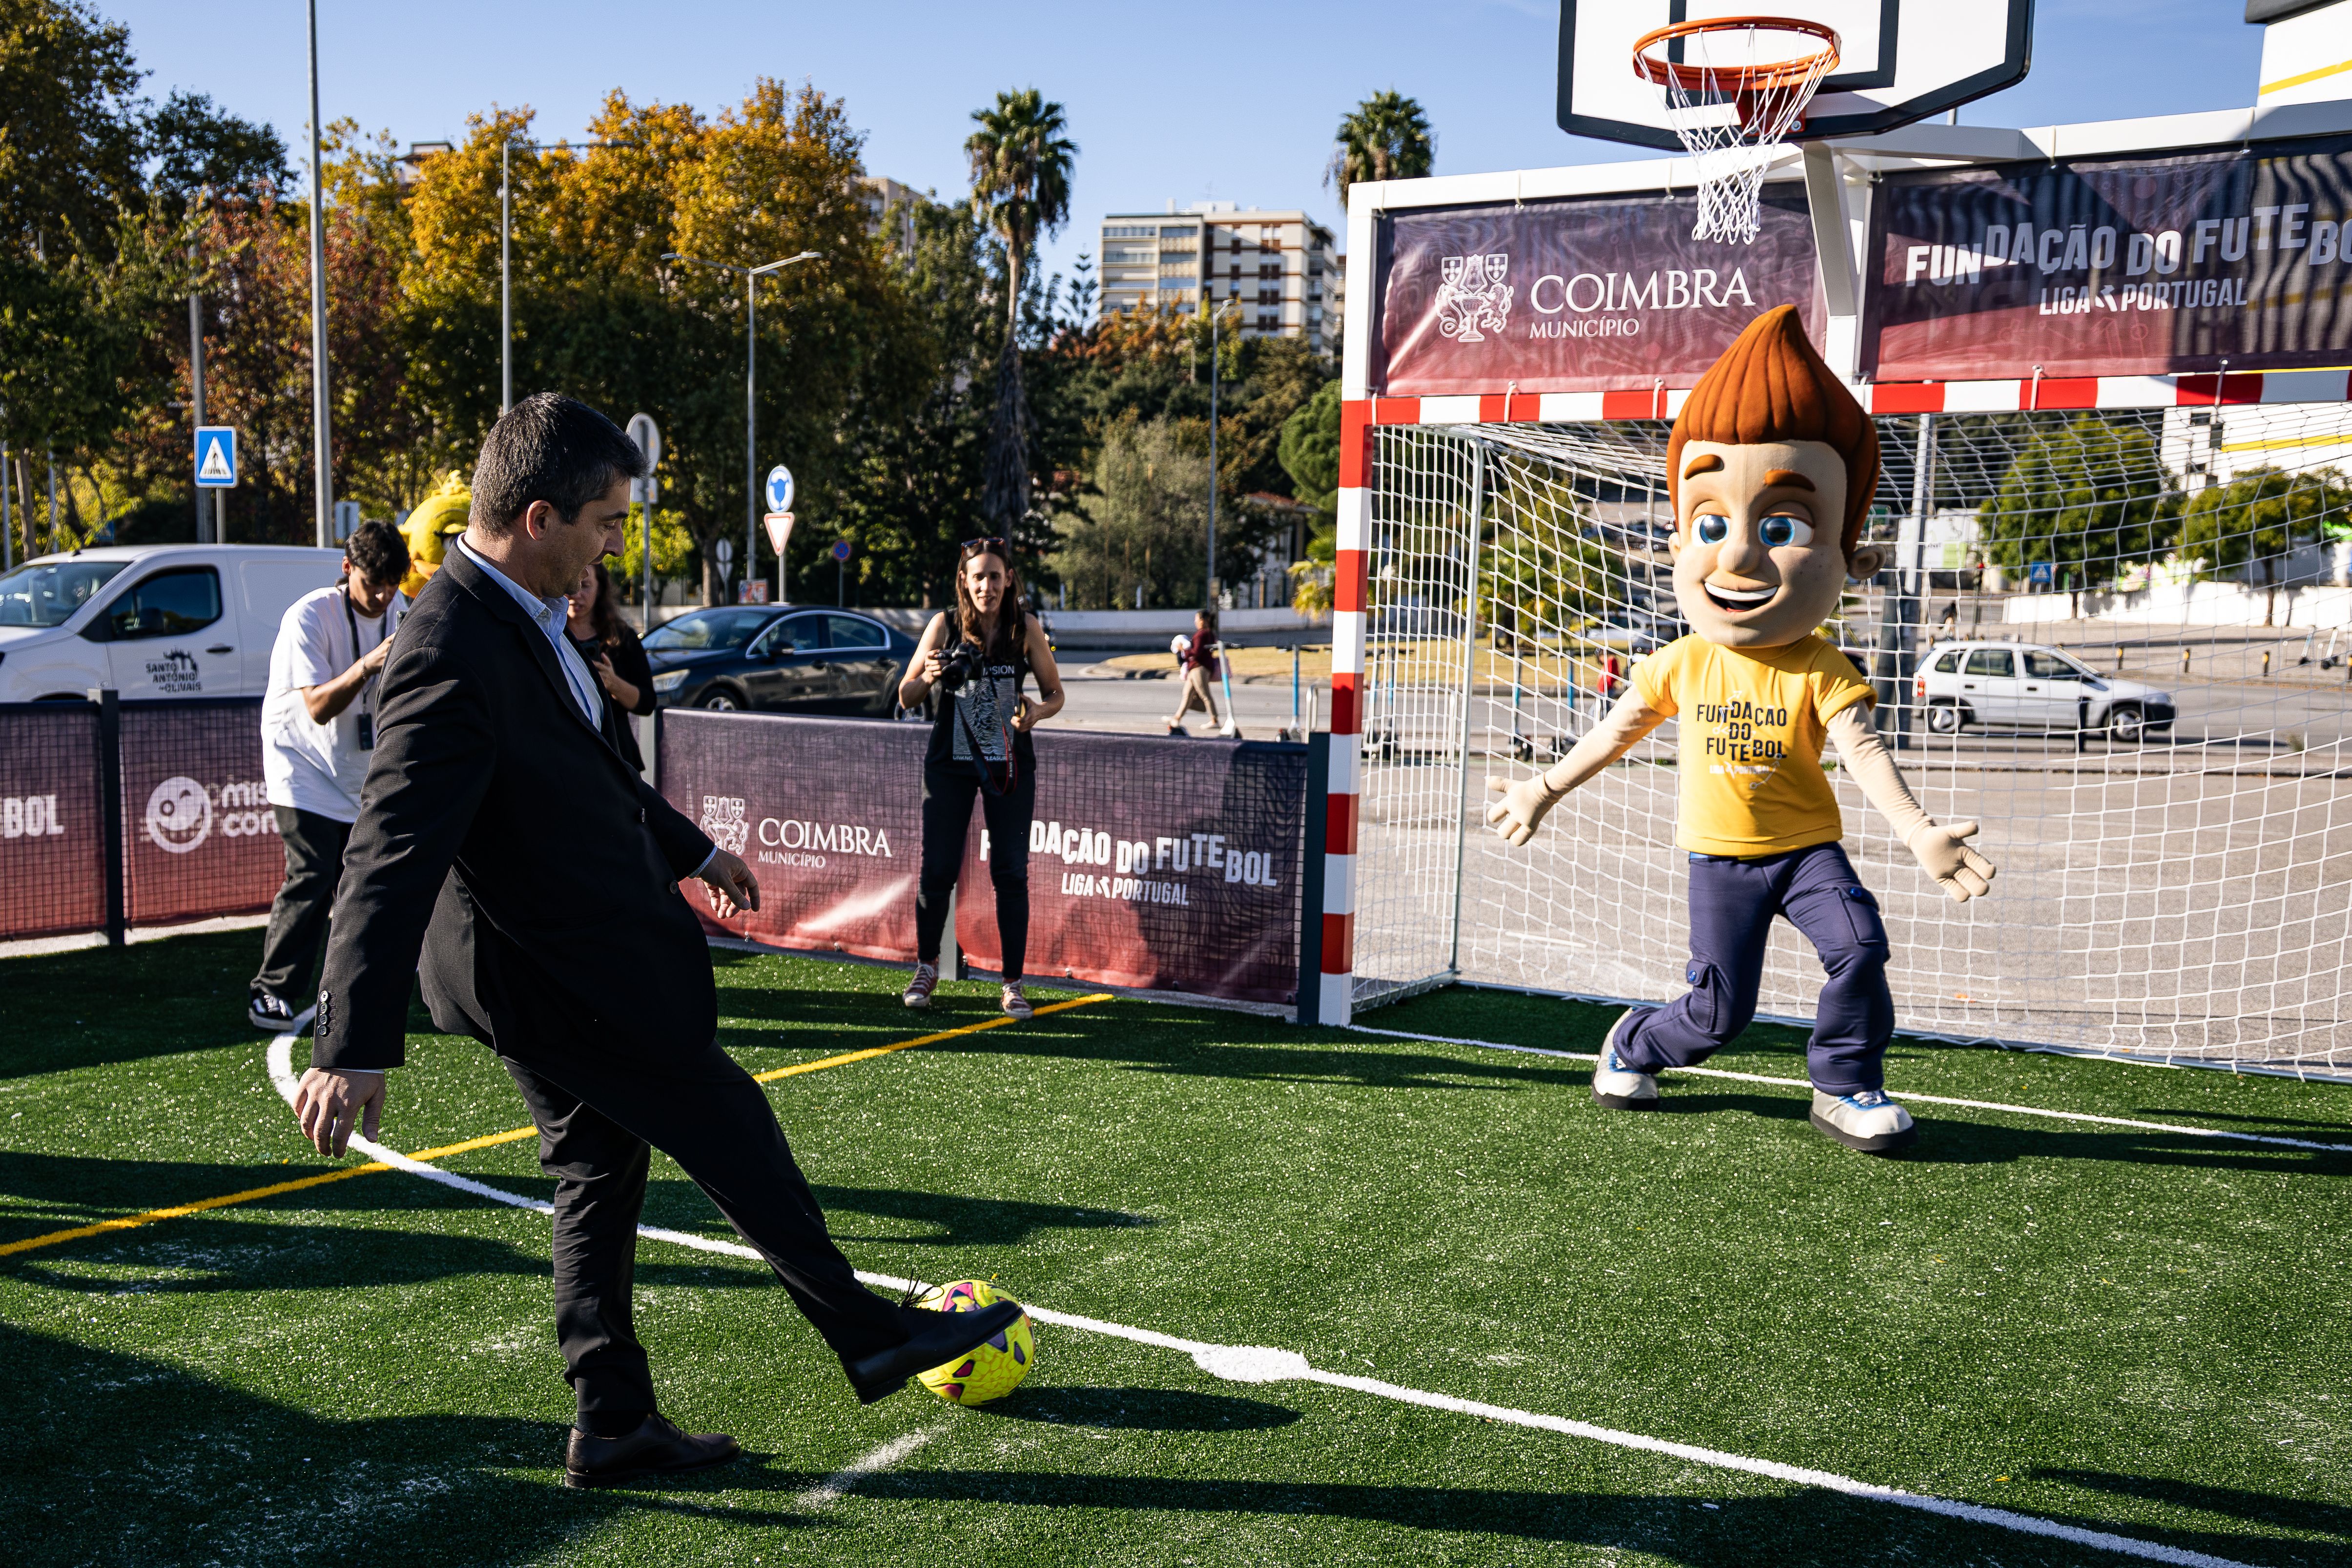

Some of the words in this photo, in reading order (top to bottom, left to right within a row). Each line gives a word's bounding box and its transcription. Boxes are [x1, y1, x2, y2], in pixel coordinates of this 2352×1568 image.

[1906, 222, 2117, 287] FUNDAÇÃO
[2126, 230, 2182, 276] DO
[1530, 267, 1756, 314] COIMBRA
[2039, 286, 2091, 315] LIGA
[2121, 278, 2248, 311] PORTUGAL
[1529, 316, 1639, 339] MUNICÍPIO
[145, 662, 177, 673] SANTO
[165, 682, 201, 692] OLIVAIS
[1729, 722, 1751, 741] DO
[1707, 738, 1787, 761] FUTEBOL
[221, 781, 267, 808] mis
[0, 794, 64, 839] BOL
[223, 810, 280, 837] con
[758, 818, 892, 858] COIMBRA
[758, 850, 826, 869] MUNICÍPIO
[979, 820, 1111, 865] FDAÇÃO
[1115, 840, 1149, 874] DO
[1156, 833, 1277, 887] FUTEBOL
[1061, 873, 1093, 897] LIGA
[1112, 877, 1189, 906] PORTUGAL
